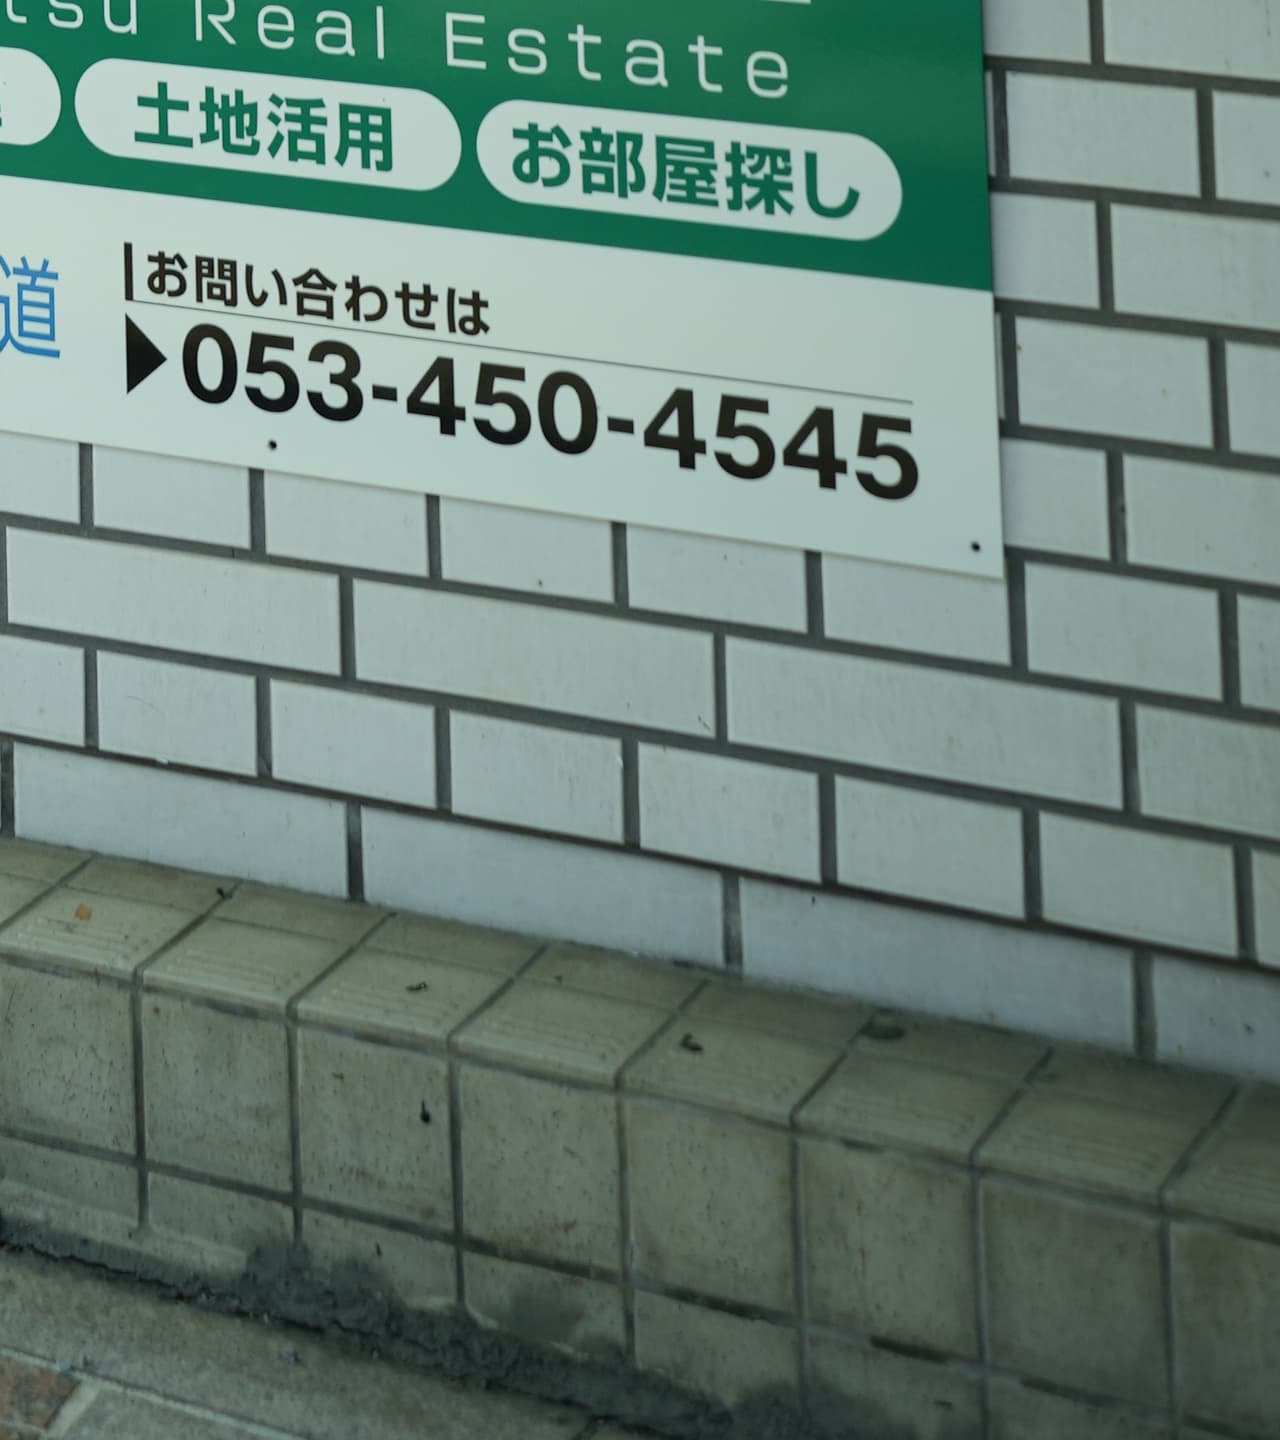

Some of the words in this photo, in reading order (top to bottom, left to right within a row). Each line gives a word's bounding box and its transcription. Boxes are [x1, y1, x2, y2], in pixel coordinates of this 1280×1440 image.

[445, 13, 791, 99] Estate
[134, 82, 395, 175] 土地活用
[511, 120, 861, 218] お部屋探し
[146, 248, 491, 337] お問い合わせは
[181, 321, 922, 502] 053-450-4545
